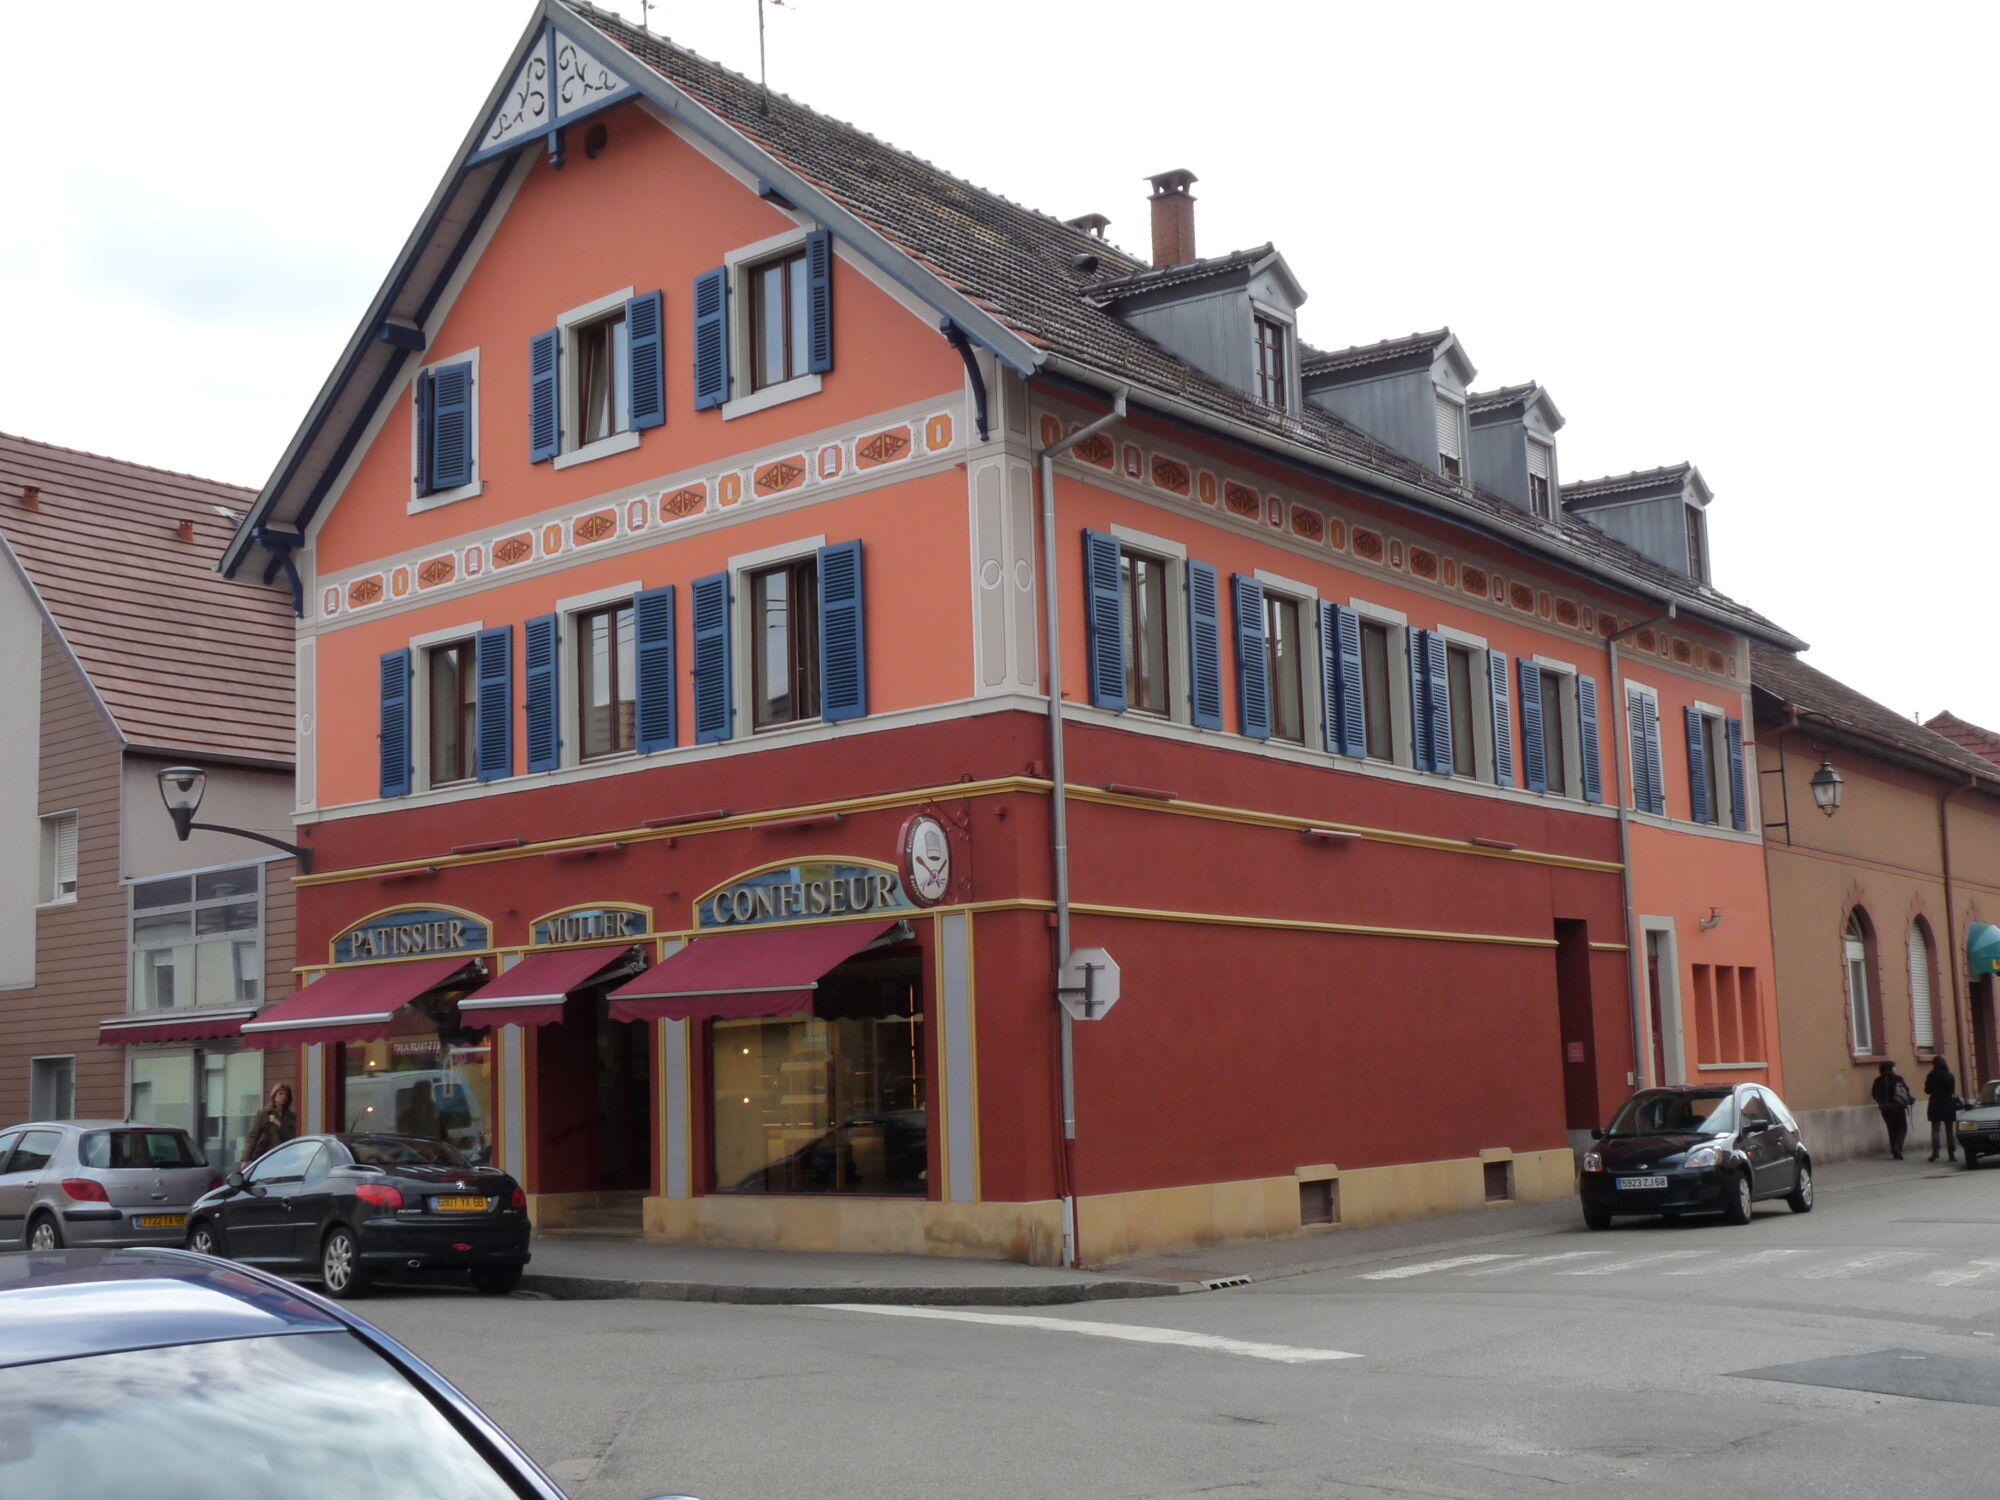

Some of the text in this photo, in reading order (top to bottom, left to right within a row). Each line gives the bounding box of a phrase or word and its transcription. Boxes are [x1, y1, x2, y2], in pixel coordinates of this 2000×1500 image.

[713, 874, 898, 924] CONFISEUR
[351, 919, 466, 959] PATISSIER
[547, 911, 630, 945] MULLER
